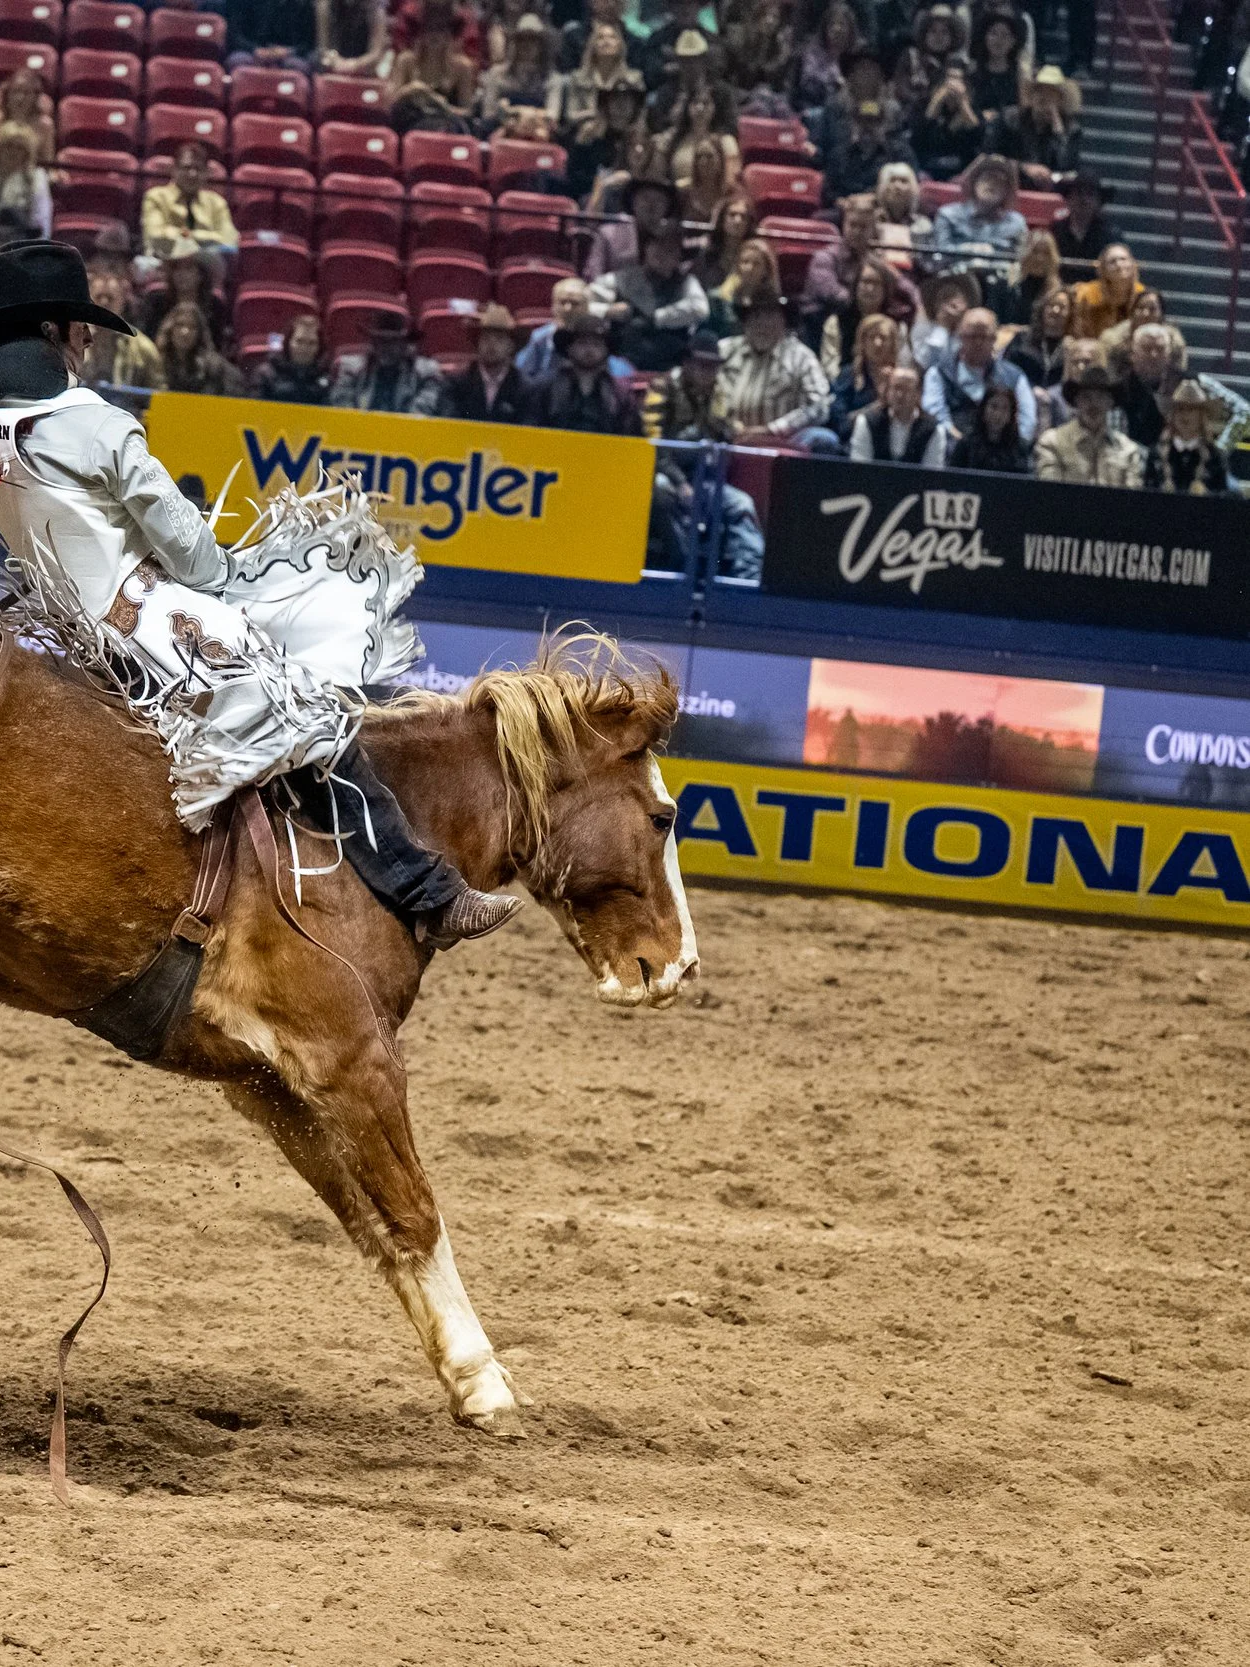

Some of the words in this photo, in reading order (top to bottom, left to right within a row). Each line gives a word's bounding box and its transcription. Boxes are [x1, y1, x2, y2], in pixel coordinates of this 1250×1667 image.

[244, 428, 558, 541] Wrangler
[930, 496, 976, 526] LAS
[820, 494, 1005, 594] Vegas
[1023, 533, 1212, 588] VISITLASVEGAS.COM
[678, 782, 1250, 904] ATIONA
